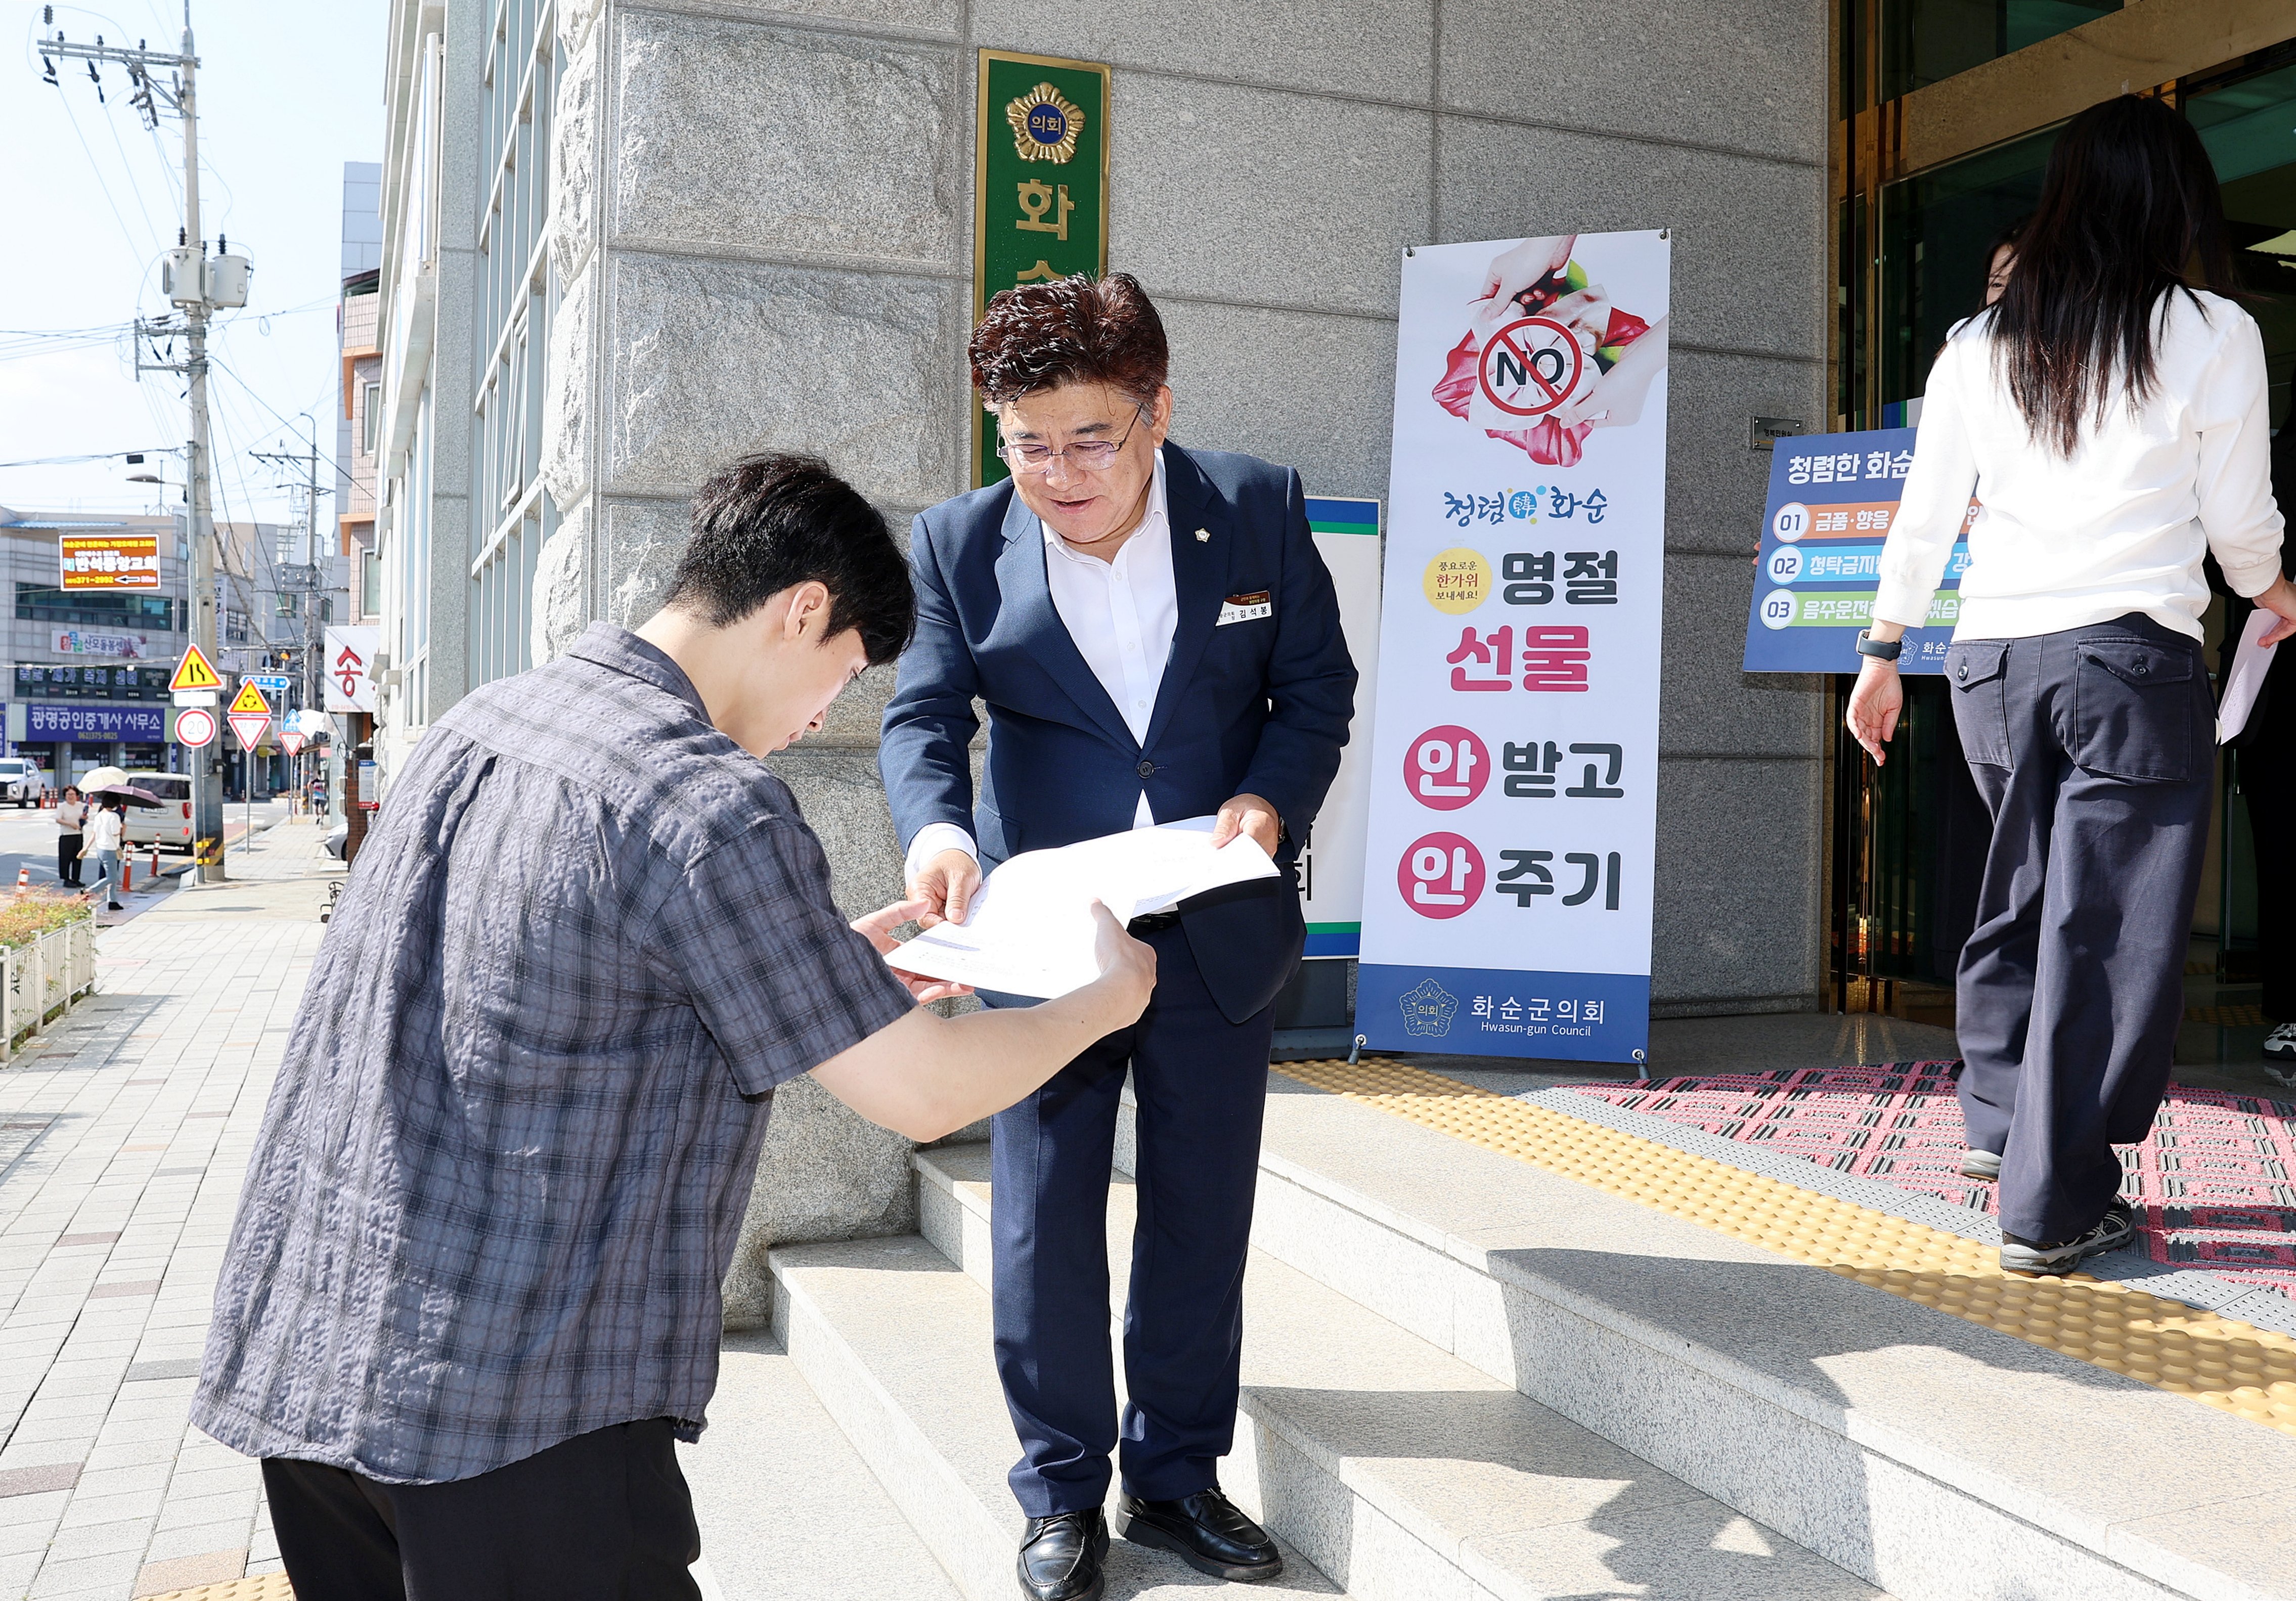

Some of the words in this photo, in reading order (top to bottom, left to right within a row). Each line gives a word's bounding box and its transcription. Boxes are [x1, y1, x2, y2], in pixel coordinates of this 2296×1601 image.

[1031, 115, 1062, 135] 의회
[1496, 348, 1565, 387] NO
[1763, 428, 1792, 437] 행복민원실
[1788, 452, 1861, 484] 청렴한
[1549, 486, 1608, 524] 화순
[1780, 514, 1801, 531] 01
[75, 556, 157, 572] 반석중앙교회
[1439, 560, 1477, 572] 풍요로운
[1774, 558, 1797, 574] 02
[1810, 555, 1881, 575] 청탁금지
[1436, 574, 1479, 588] 한가위
[1502, 550, 1618, 606] 명절
[1435, 590, 1478, 601] 보내세요!
[1240, 606, 1267, 618] 김석봉
[1767, 601, 1791, 618] 03
[1803, 600, 1874, 619] 음주운전
[1922, 642, 1953, 654] 화순
[1446, 624, 1591, 693] 선물
[334, 646, 363, 697] 송
[31, 710, 122, 731] 광명공인중개사
[125, 713, 161, 730] 사무소
[188, 721, 205, 734] 20
[1417, 739, 1478, 797] 안
[1502, 740, 1625, 799] 받고
[1411, 847, 1472, 905] 안
[1495, 850, 1621, 910] 주기
[1417, 1004, 1439, 1017] 의회
[1471, 994, 1605, 1024] 화순군의회
[1481, 1021, 1548, 1036] Hwasun-gun
[1552, 1023, 1591, 1037] Council
